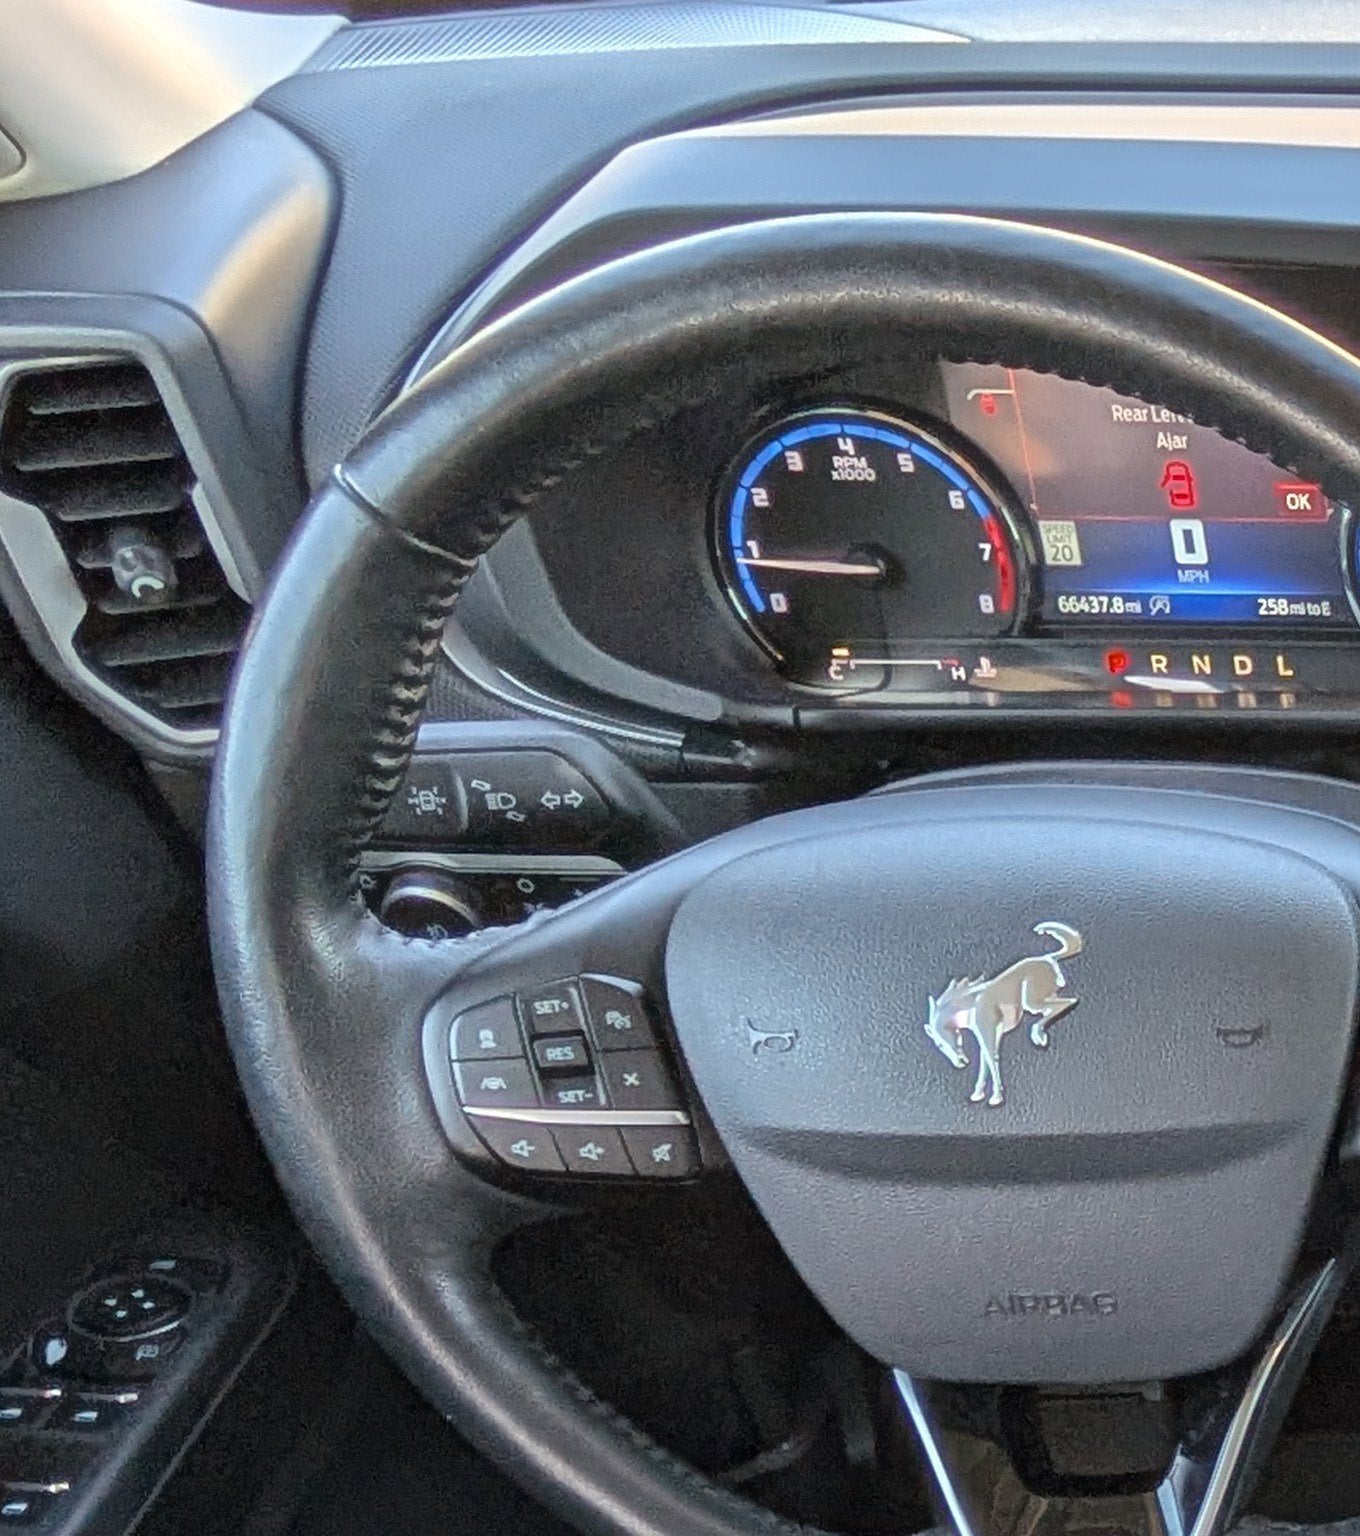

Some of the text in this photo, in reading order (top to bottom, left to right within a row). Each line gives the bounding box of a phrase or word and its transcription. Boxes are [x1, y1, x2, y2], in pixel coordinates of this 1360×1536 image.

[1111, 404, 1148, 422] Rear
[837, 437, 855, 455] 4
[1156, 432, 1188, 451] Ajar
[785, 451, 803, 472] 3
[832, 456, 868, 469] RPM
[898, 453, 914, 472] 5
[831, 468, 877, 481] x1000
[751, 488, 769, 507] 2
[949, 490, 965, 510] 6
[1286, 493, 1311, 510] OK
[747, 541, 759, 559] 1
[1169, 518, 1208, 565] 0
[979, 543, 992, 561] 7
[1050, 544, 1073, 562] 20
[1177, 570, 1209, 583] MPH
[770, 594, 788, 613] 0
[979, 595, 994, 614] 8
[1058, 597, 1124, 614] 66437.8
[1258, 599, 1288, 616] 258
[1109, 651, 1294, 675] P R N D L
[546, 1046, 575, 1060] RES
